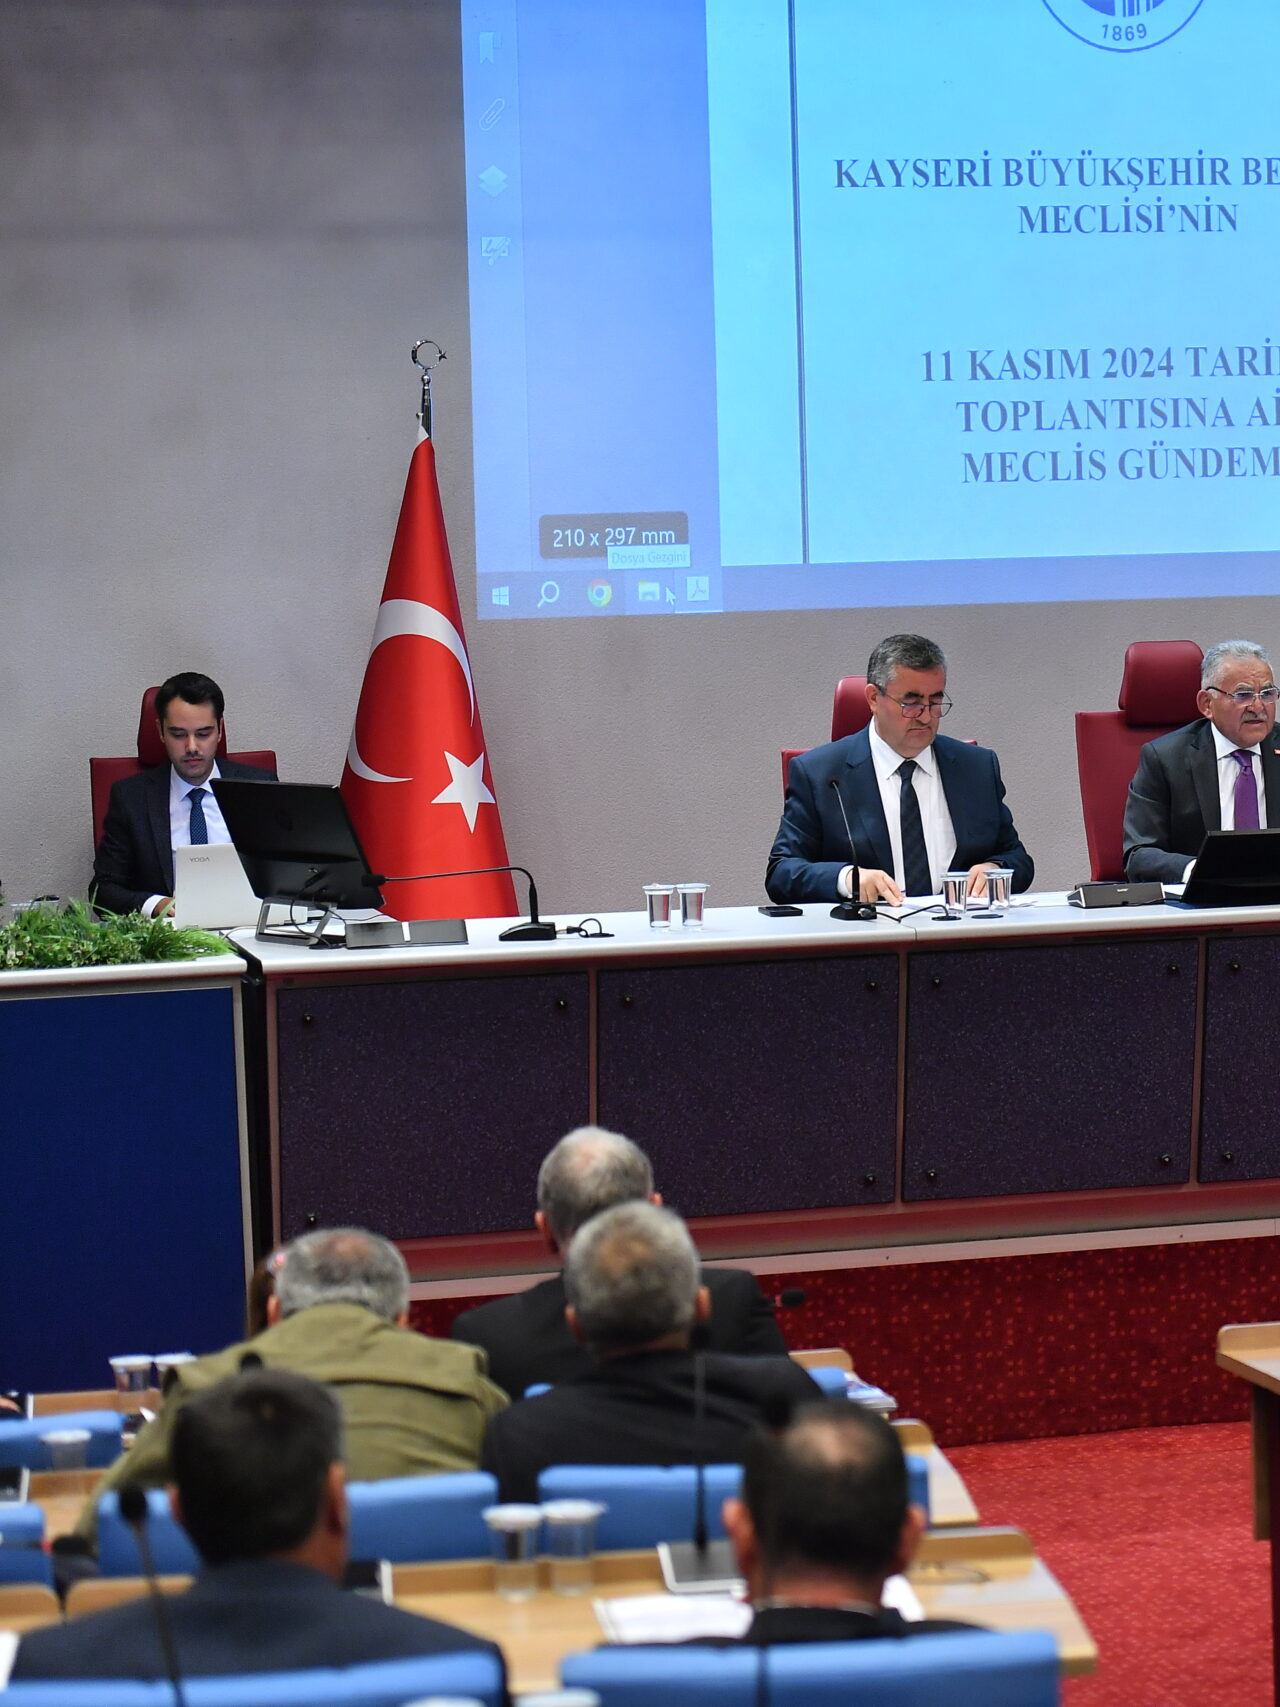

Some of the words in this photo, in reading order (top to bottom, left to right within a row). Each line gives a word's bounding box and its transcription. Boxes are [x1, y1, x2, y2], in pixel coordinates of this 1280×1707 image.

[1101, 23, 1148, 41] 1869
[834, 150, 991, 189] KAYSERİ
[1002, 149, 1232, 192] BÜYÜKŞEHİR
[921, 350, 952, 382] 11
[968, 348, 1090, 381] KASIM
[1102, 346, 1174, 379] 2024
[955, 396, 1237, 432] TOPLANTISINA
[961, 442, 1106, 483] MECLİS
[553, 529, 585, 547] 210
[589, 533, 599, 545] x
[605, 527, 636, 545] 297
[642, 530, 675, 544] mm
[611, 551, 645, 566] Dosya
[648, 550, 687, 565] Gezgini
